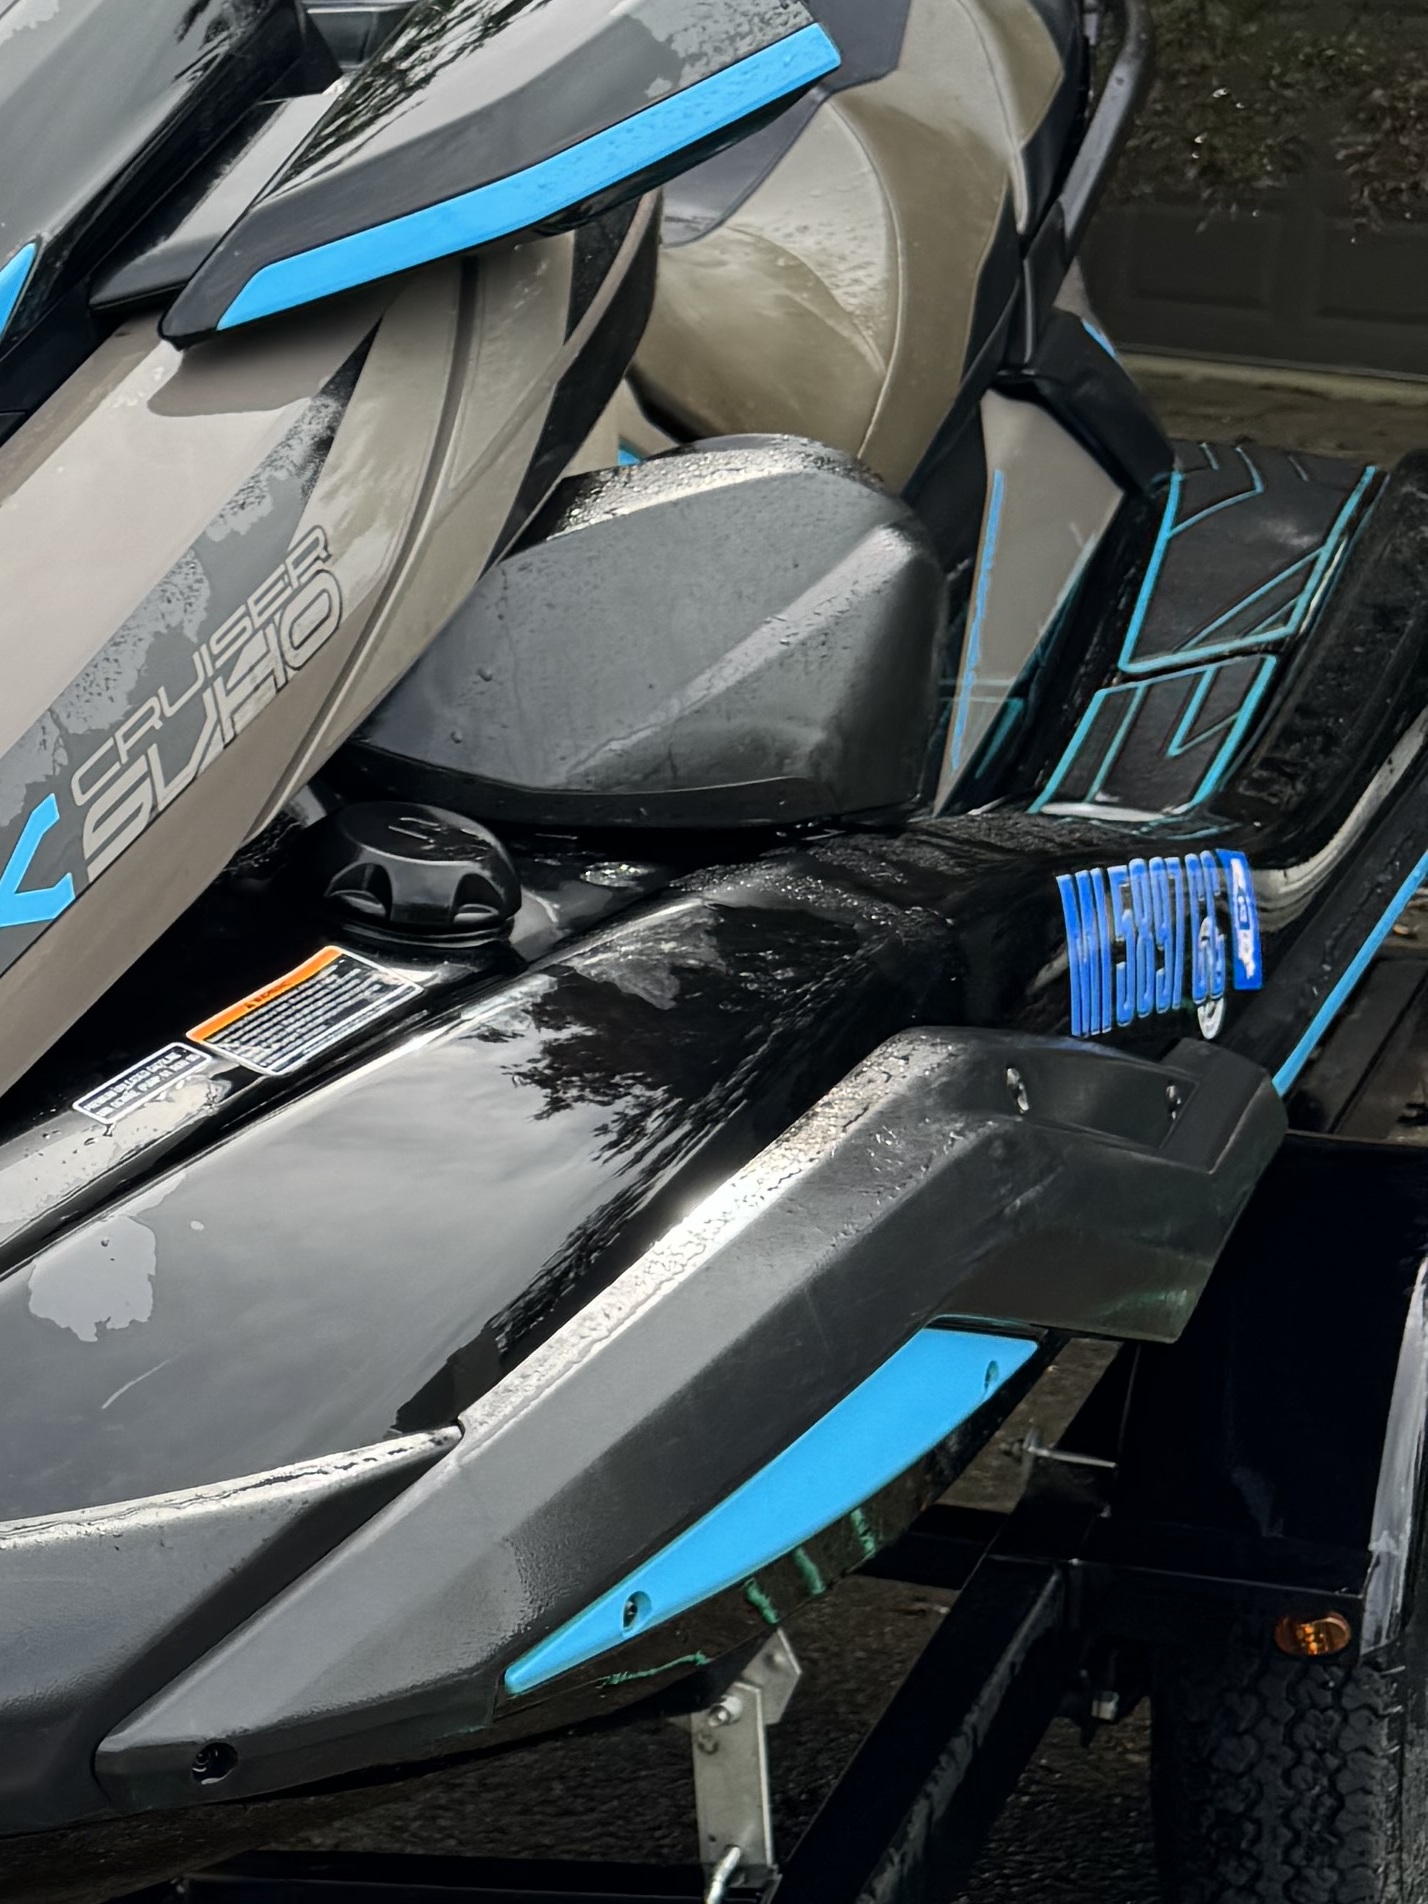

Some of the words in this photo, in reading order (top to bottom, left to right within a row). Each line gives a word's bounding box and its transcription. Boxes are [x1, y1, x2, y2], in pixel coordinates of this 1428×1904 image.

[70, 525, 333, 806] CRUISER
[82, 568, 343, 883] SVHO
[1106, 856, 1184, 1027] 5897
